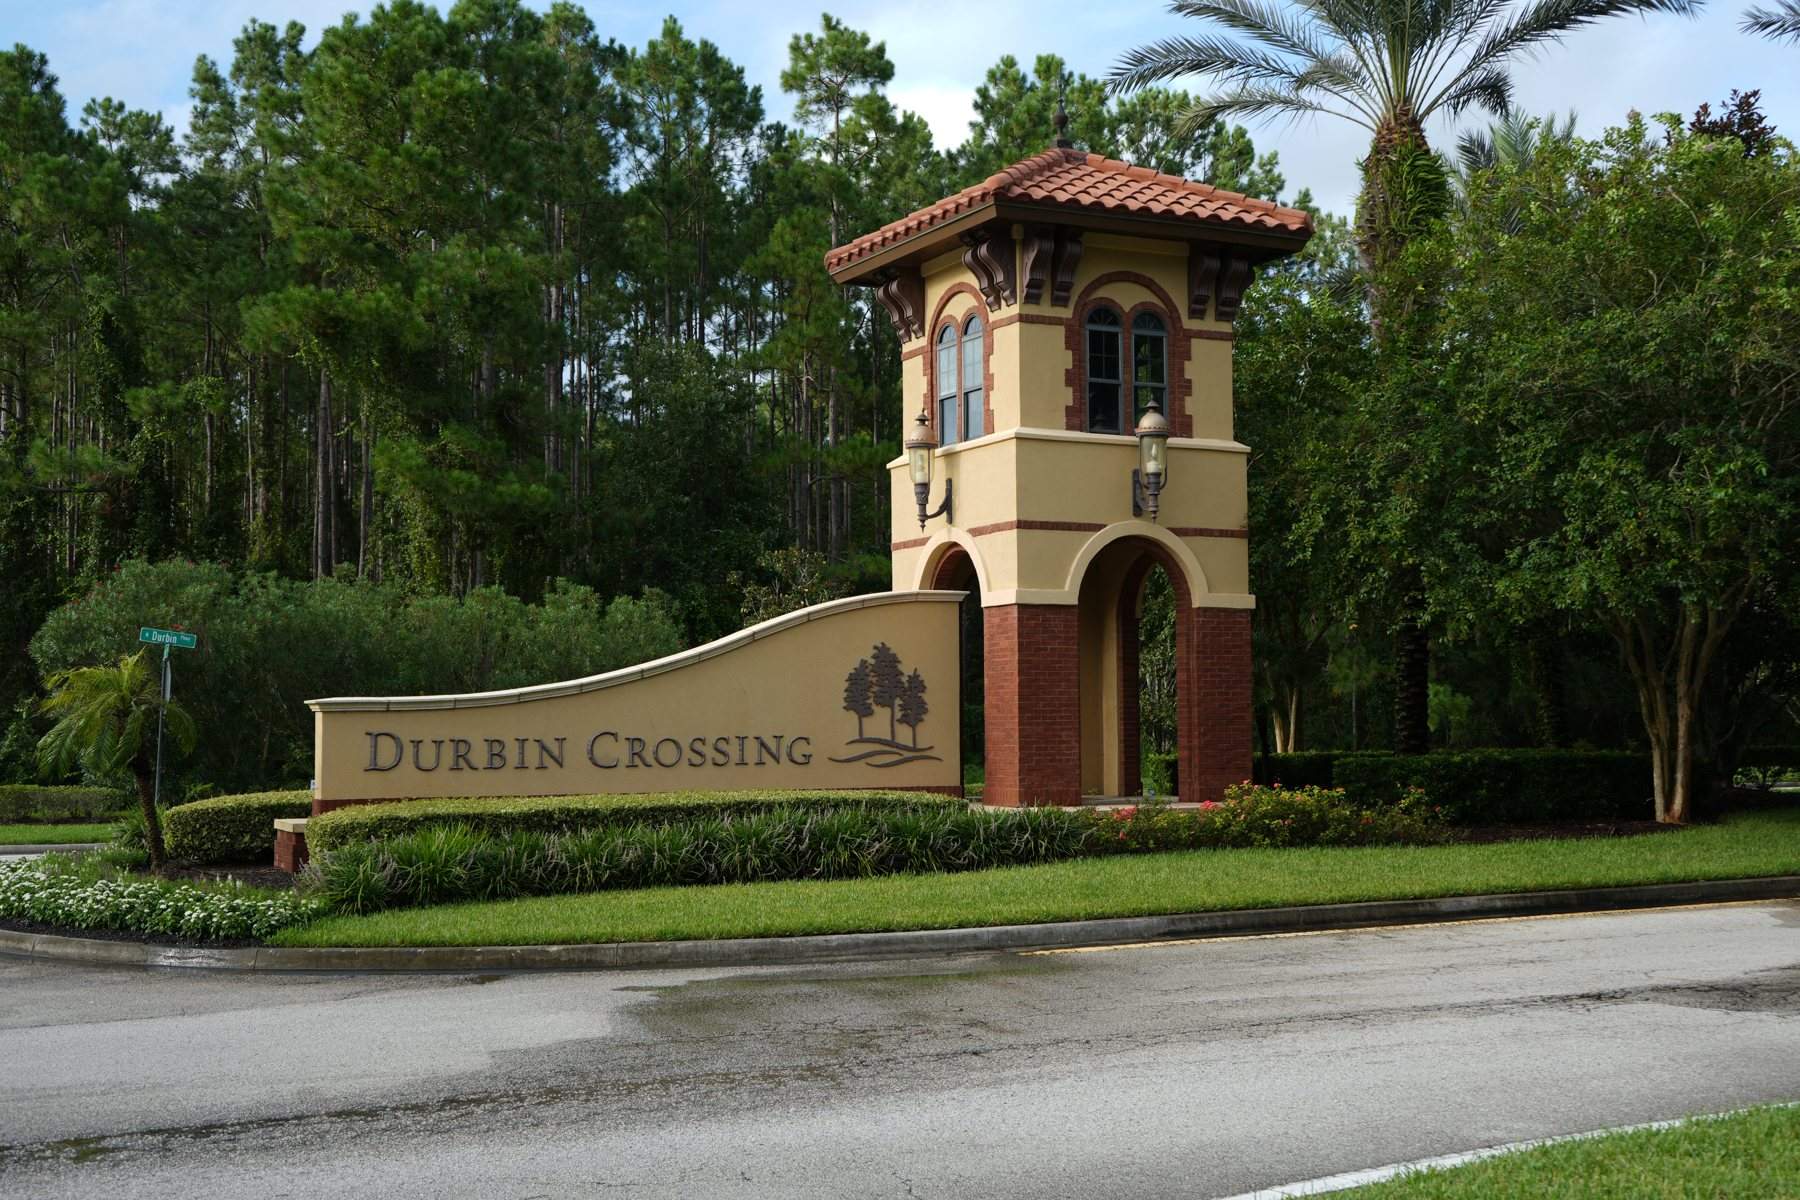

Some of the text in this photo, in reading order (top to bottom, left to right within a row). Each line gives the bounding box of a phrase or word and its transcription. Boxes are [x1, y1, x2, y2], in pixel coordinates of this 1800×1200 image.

[151, 631, 177, 644] Durbin
[363, 731, 813, 772] DURBIN CROSSING
